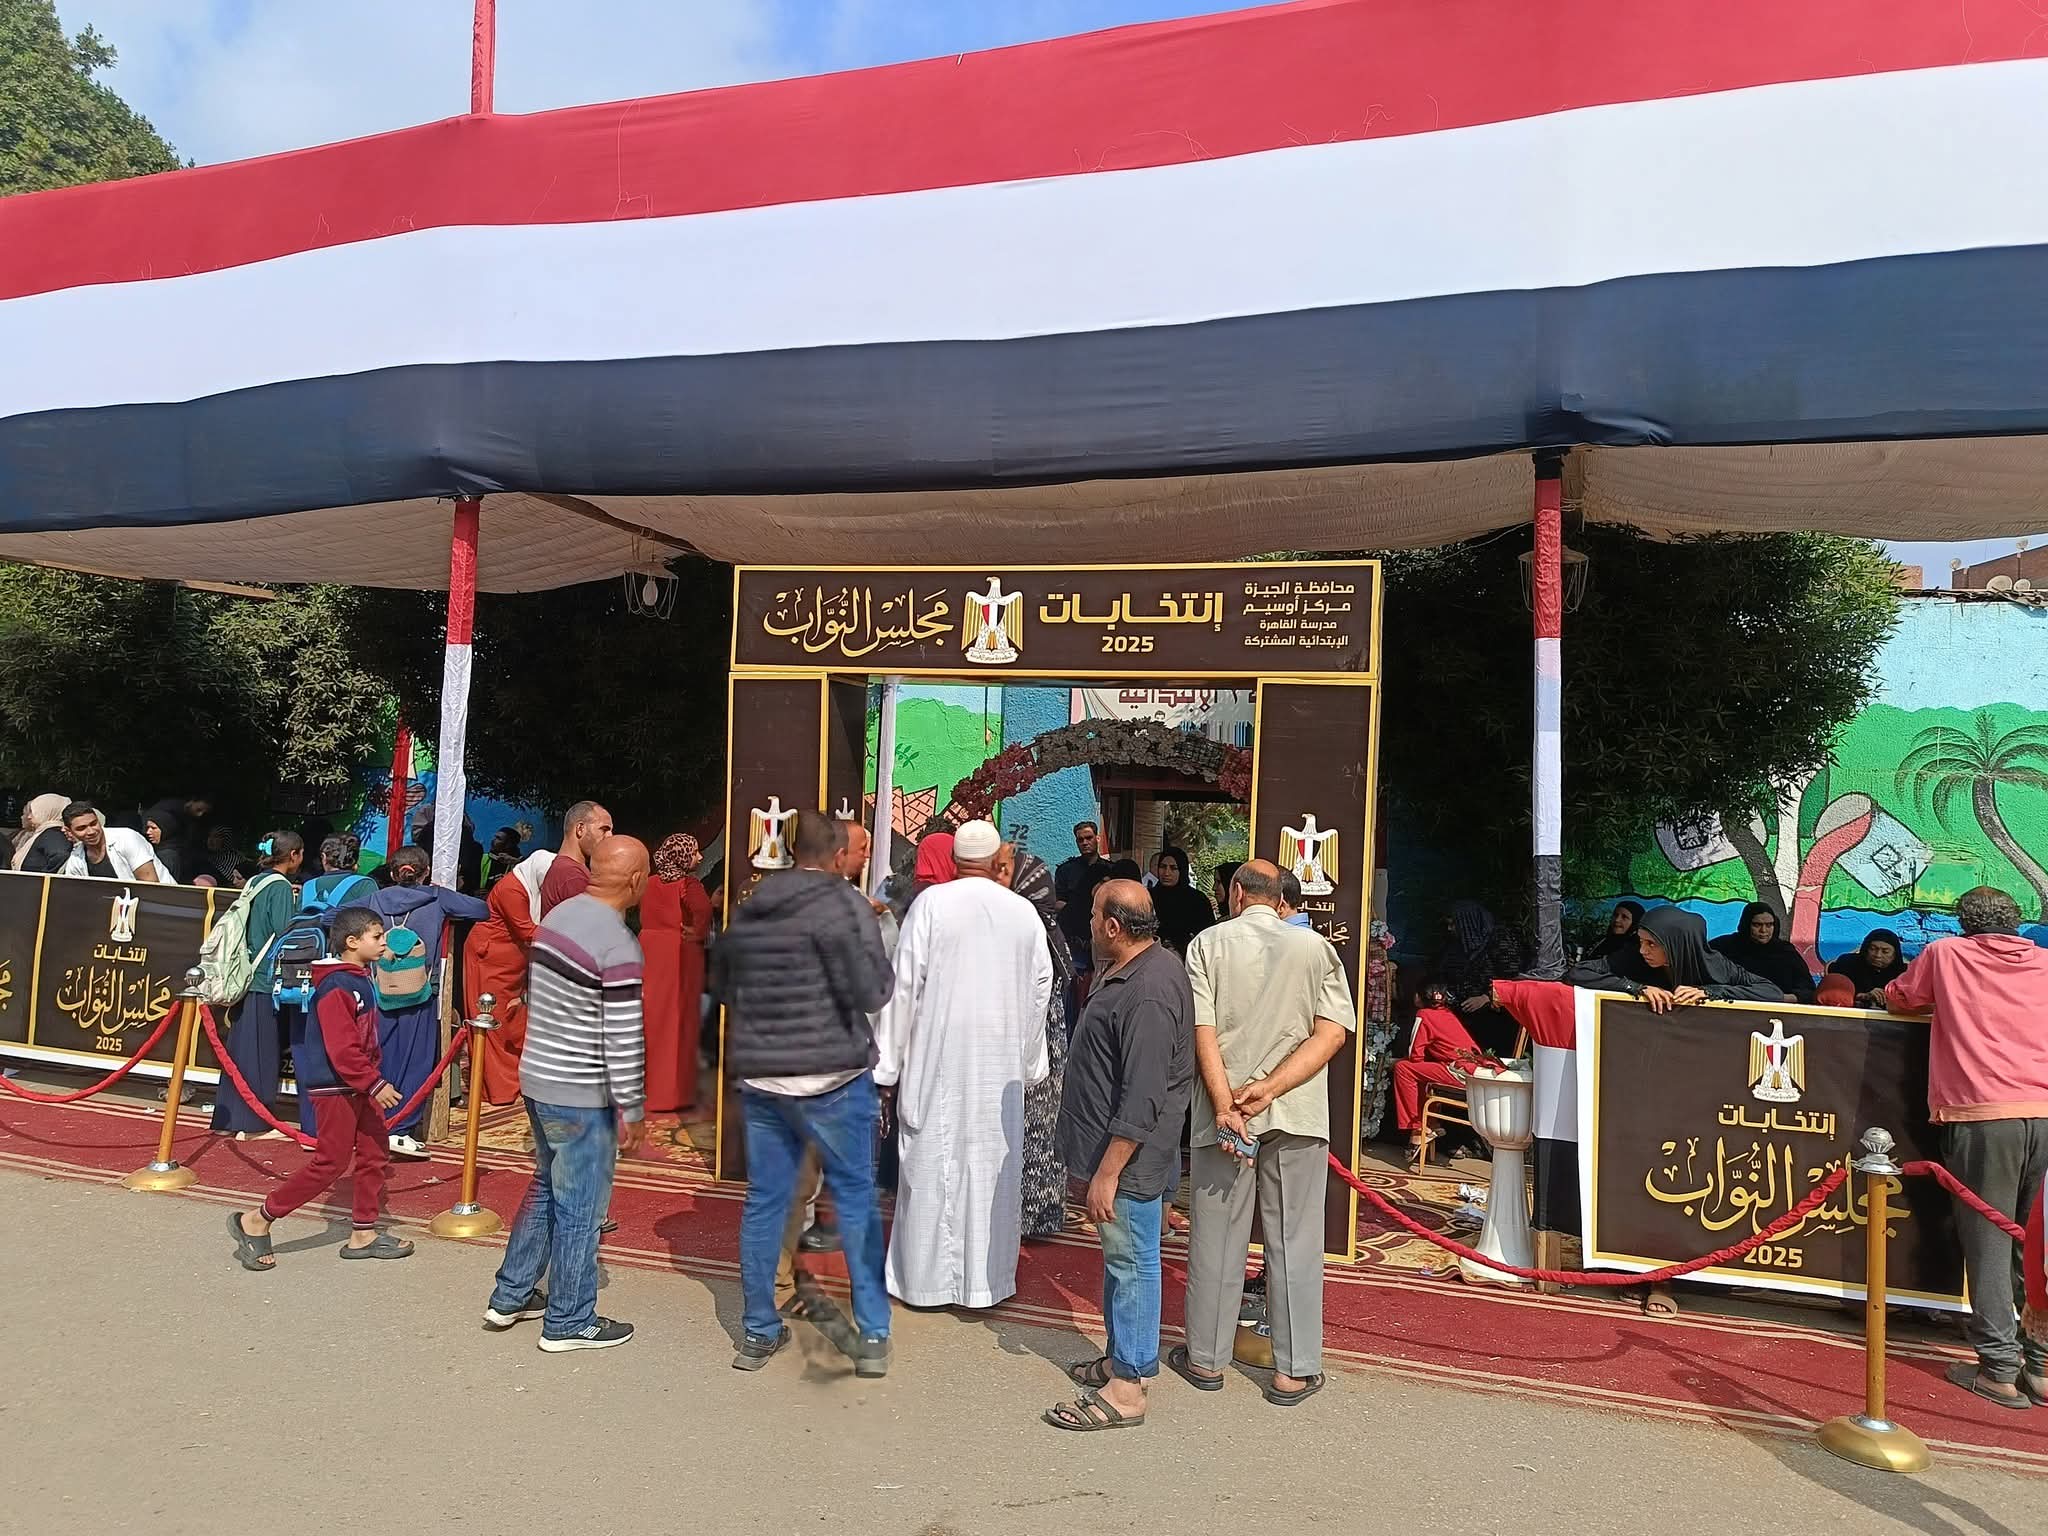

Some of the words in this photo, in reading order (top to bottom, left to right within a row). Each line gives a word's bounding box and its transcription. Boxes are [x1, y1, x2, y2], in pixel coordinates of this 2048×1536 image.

[1244, 581, 1290, 598] الجيزة
[1294, 581, 1355, 594] محافظة
[1039, 591, 1224, 632] إنتخابات
[1242, 595, 1300, 616] أوسيم
[1302, 599, 1351, 615] مركز
[1260, 619, 1297, 631] القاهرة
[1300, 619, 1337, 631] مدرسة
[1101, 636, 1154, 653] 2025
[1244, 633, 1296, 648] المشتركة
[1299, 635, 1349, 649] الإبتدائية
[94, 944, 147, 967] إنتخابات
[96, 1036, 123, 1052] 2025
[281, 1059, 295, 1074] 25
[1717, 1104, 1836, 1141] إنتخابات
[1743, 1245, 1803, 1268] 2025
